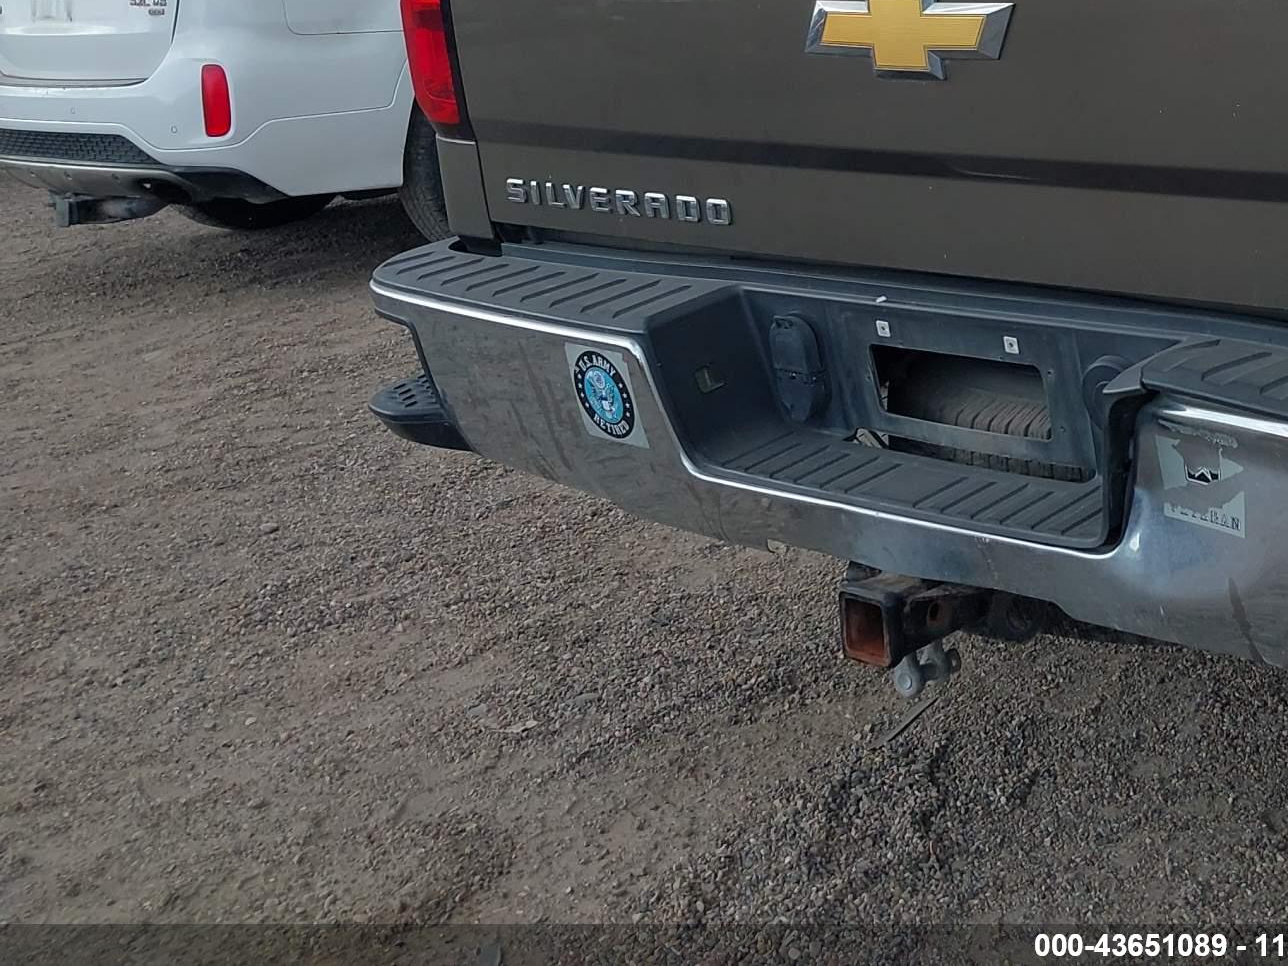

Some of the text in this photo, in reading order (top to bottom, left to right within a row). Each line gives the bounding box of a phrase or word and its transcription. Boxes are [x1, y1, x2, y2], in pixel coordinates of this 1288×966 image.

[505, 177, 733, 226] SILVERADO
[591, 354, 616, 377] ARMY
[593, 413, 630, 435] RETIRED
